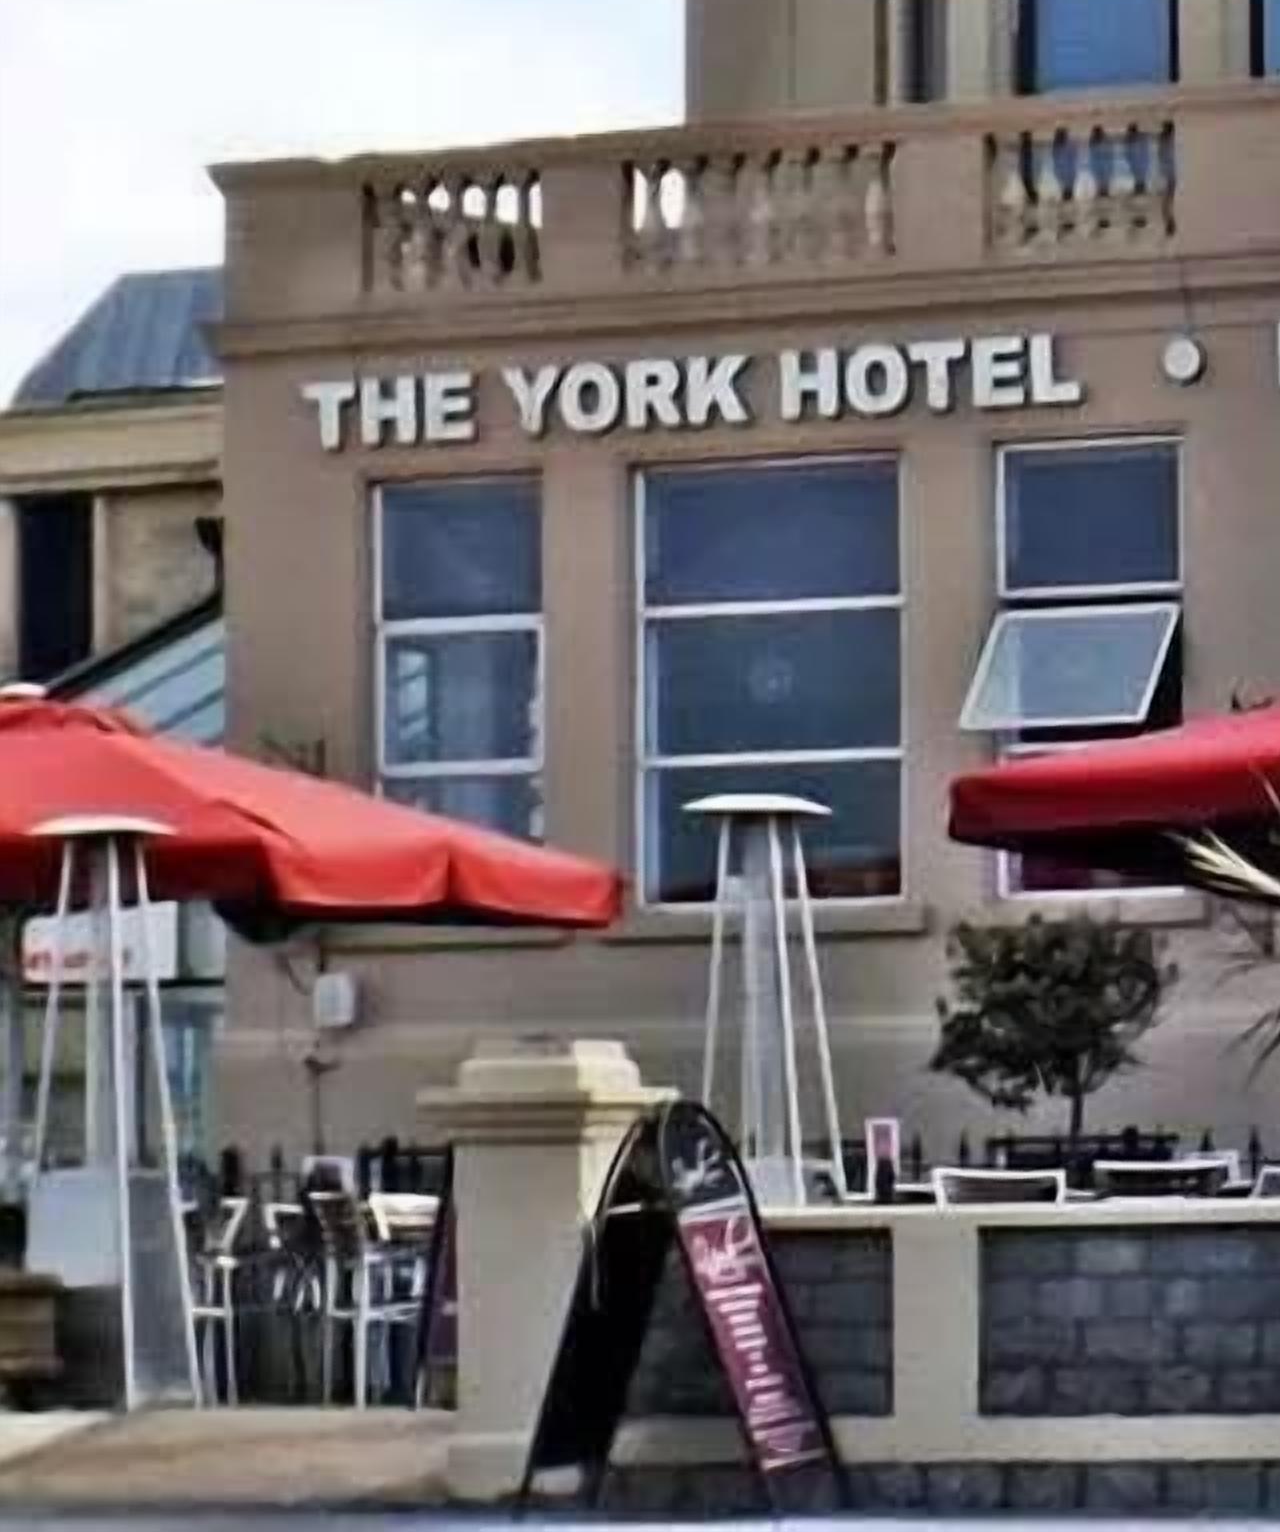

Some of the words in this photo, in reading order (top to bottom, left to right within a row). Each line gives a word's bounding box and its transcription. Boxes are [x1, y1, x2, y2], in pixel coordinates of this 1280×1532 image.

[303, 371, 476, 451] THE
[504, 354, 749, 434] YORK
[779, 333, 1082, 421] HOTEL
